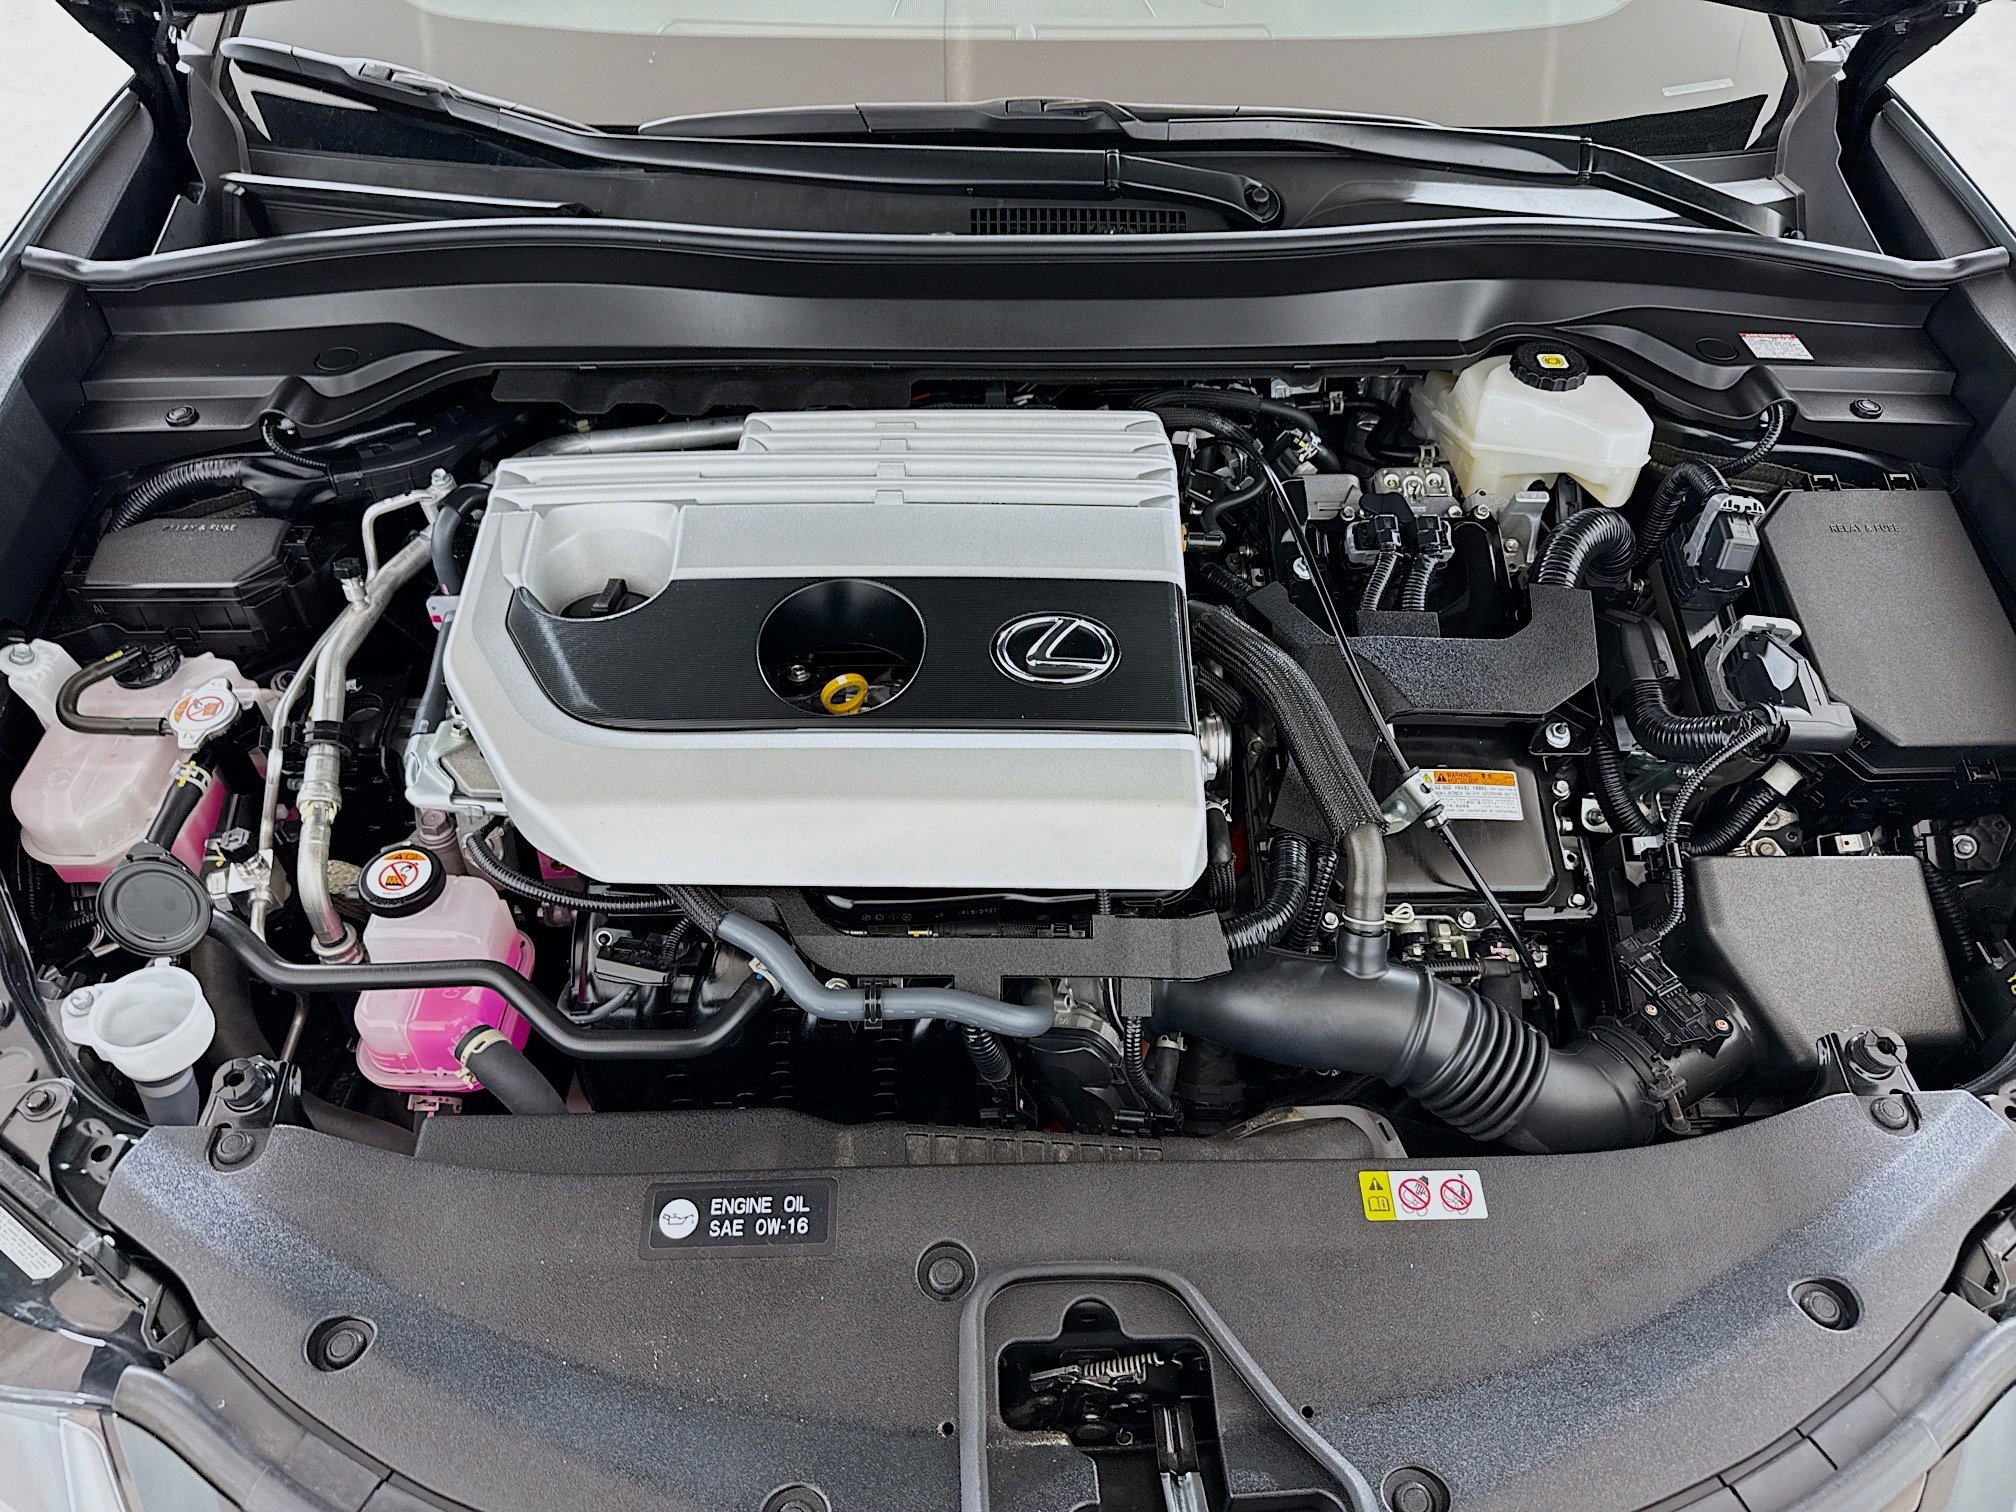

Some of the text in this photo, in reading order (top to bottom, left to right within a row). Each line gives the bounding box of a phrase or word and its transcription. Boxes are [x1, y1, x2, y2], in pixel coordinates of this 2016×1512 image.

[209, 524, 238, 532] FUSE
[1829, 524, 1861, 533] RELAY
[1873, 524, 1900, 533] FUSE
[710, 1195, 811, 1216] ENGINE OIL
[709, 1217, 809, 1237] SAE 0W-16
